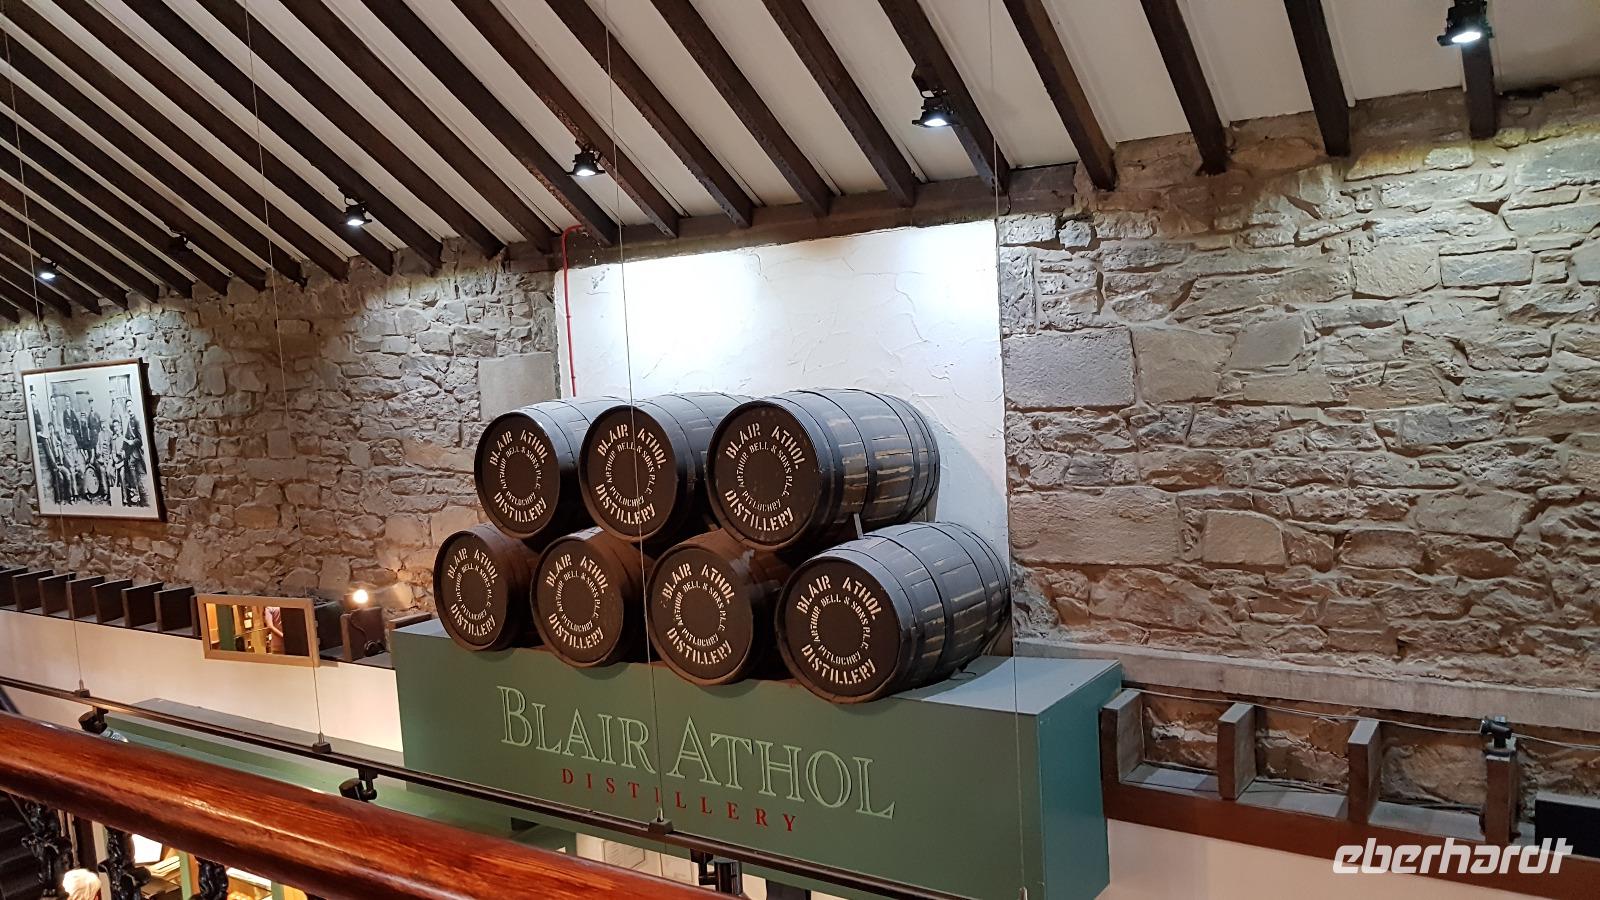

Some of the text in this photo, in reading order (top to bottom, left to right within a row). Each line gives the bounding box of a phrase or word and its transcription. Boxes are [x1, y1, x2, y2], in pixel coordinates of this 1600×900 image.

[490, 429, 548, 466] BLAIR ATHOL
[597, 424, 667, 469] BLAIR ATHOL
[725, 422, 806, 469] BLAIR ATHOL
[494, 492, 547, 522] DISTILLERY
[595, 484, 656, 525] DISTILLERY
[725, 489, 794, 531] DISTILLERY
[742, 490, 781, 512] PITLOCHRY
[447, 548, 498, 584] BLAIR ATHOL
[546, 554, 609, 594] BLAIR ATHOL
[661, 563, 735, 604] BLAIR ATHOL
[796, 575, 882, 620] BLAIR ATHOL
[450, 603, 496, 637] DISTILLERY
[548, 613, 604, 649] DISTILLERY
[666, 627, 732, 665] DISTILLERY
[801, 644, 876, 684] DISTILLERY
[818, 644, 860, 665] PITLOCHRY
[496, 685, 897, 820] BLAIR ATHOL
[561, 768, 798, 833] DISTILLERY
